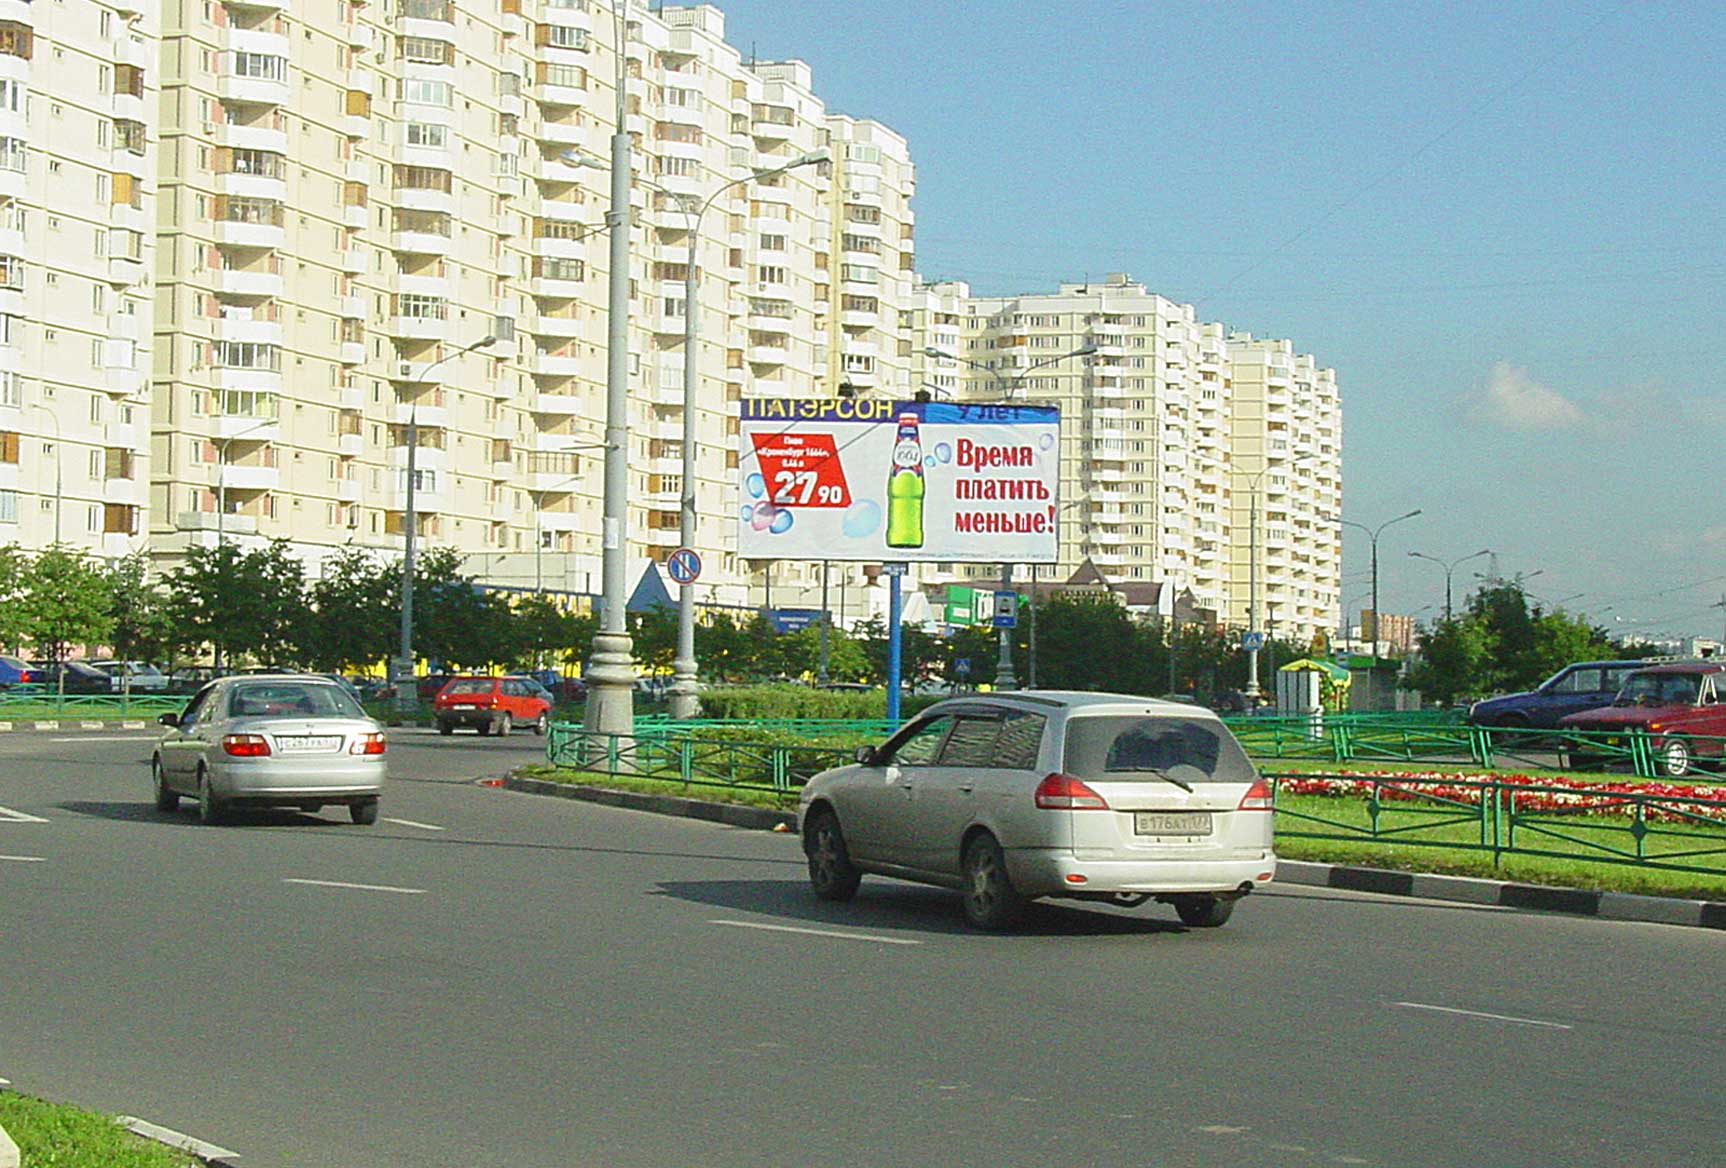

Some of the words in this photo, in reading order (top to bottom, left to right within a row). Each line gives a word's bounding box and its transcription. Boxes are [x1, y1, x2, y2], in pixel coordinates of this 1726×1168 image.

[748, 399, 894, 419] ПАТЭРСОН
[956, 438, 1033, 473] Время
[774, 470, 819, 504] 27
[817, 485, 843, 504] 90
[955, 479, 1050, 500] платить
[954, 504, 1056, 534] меньше!
